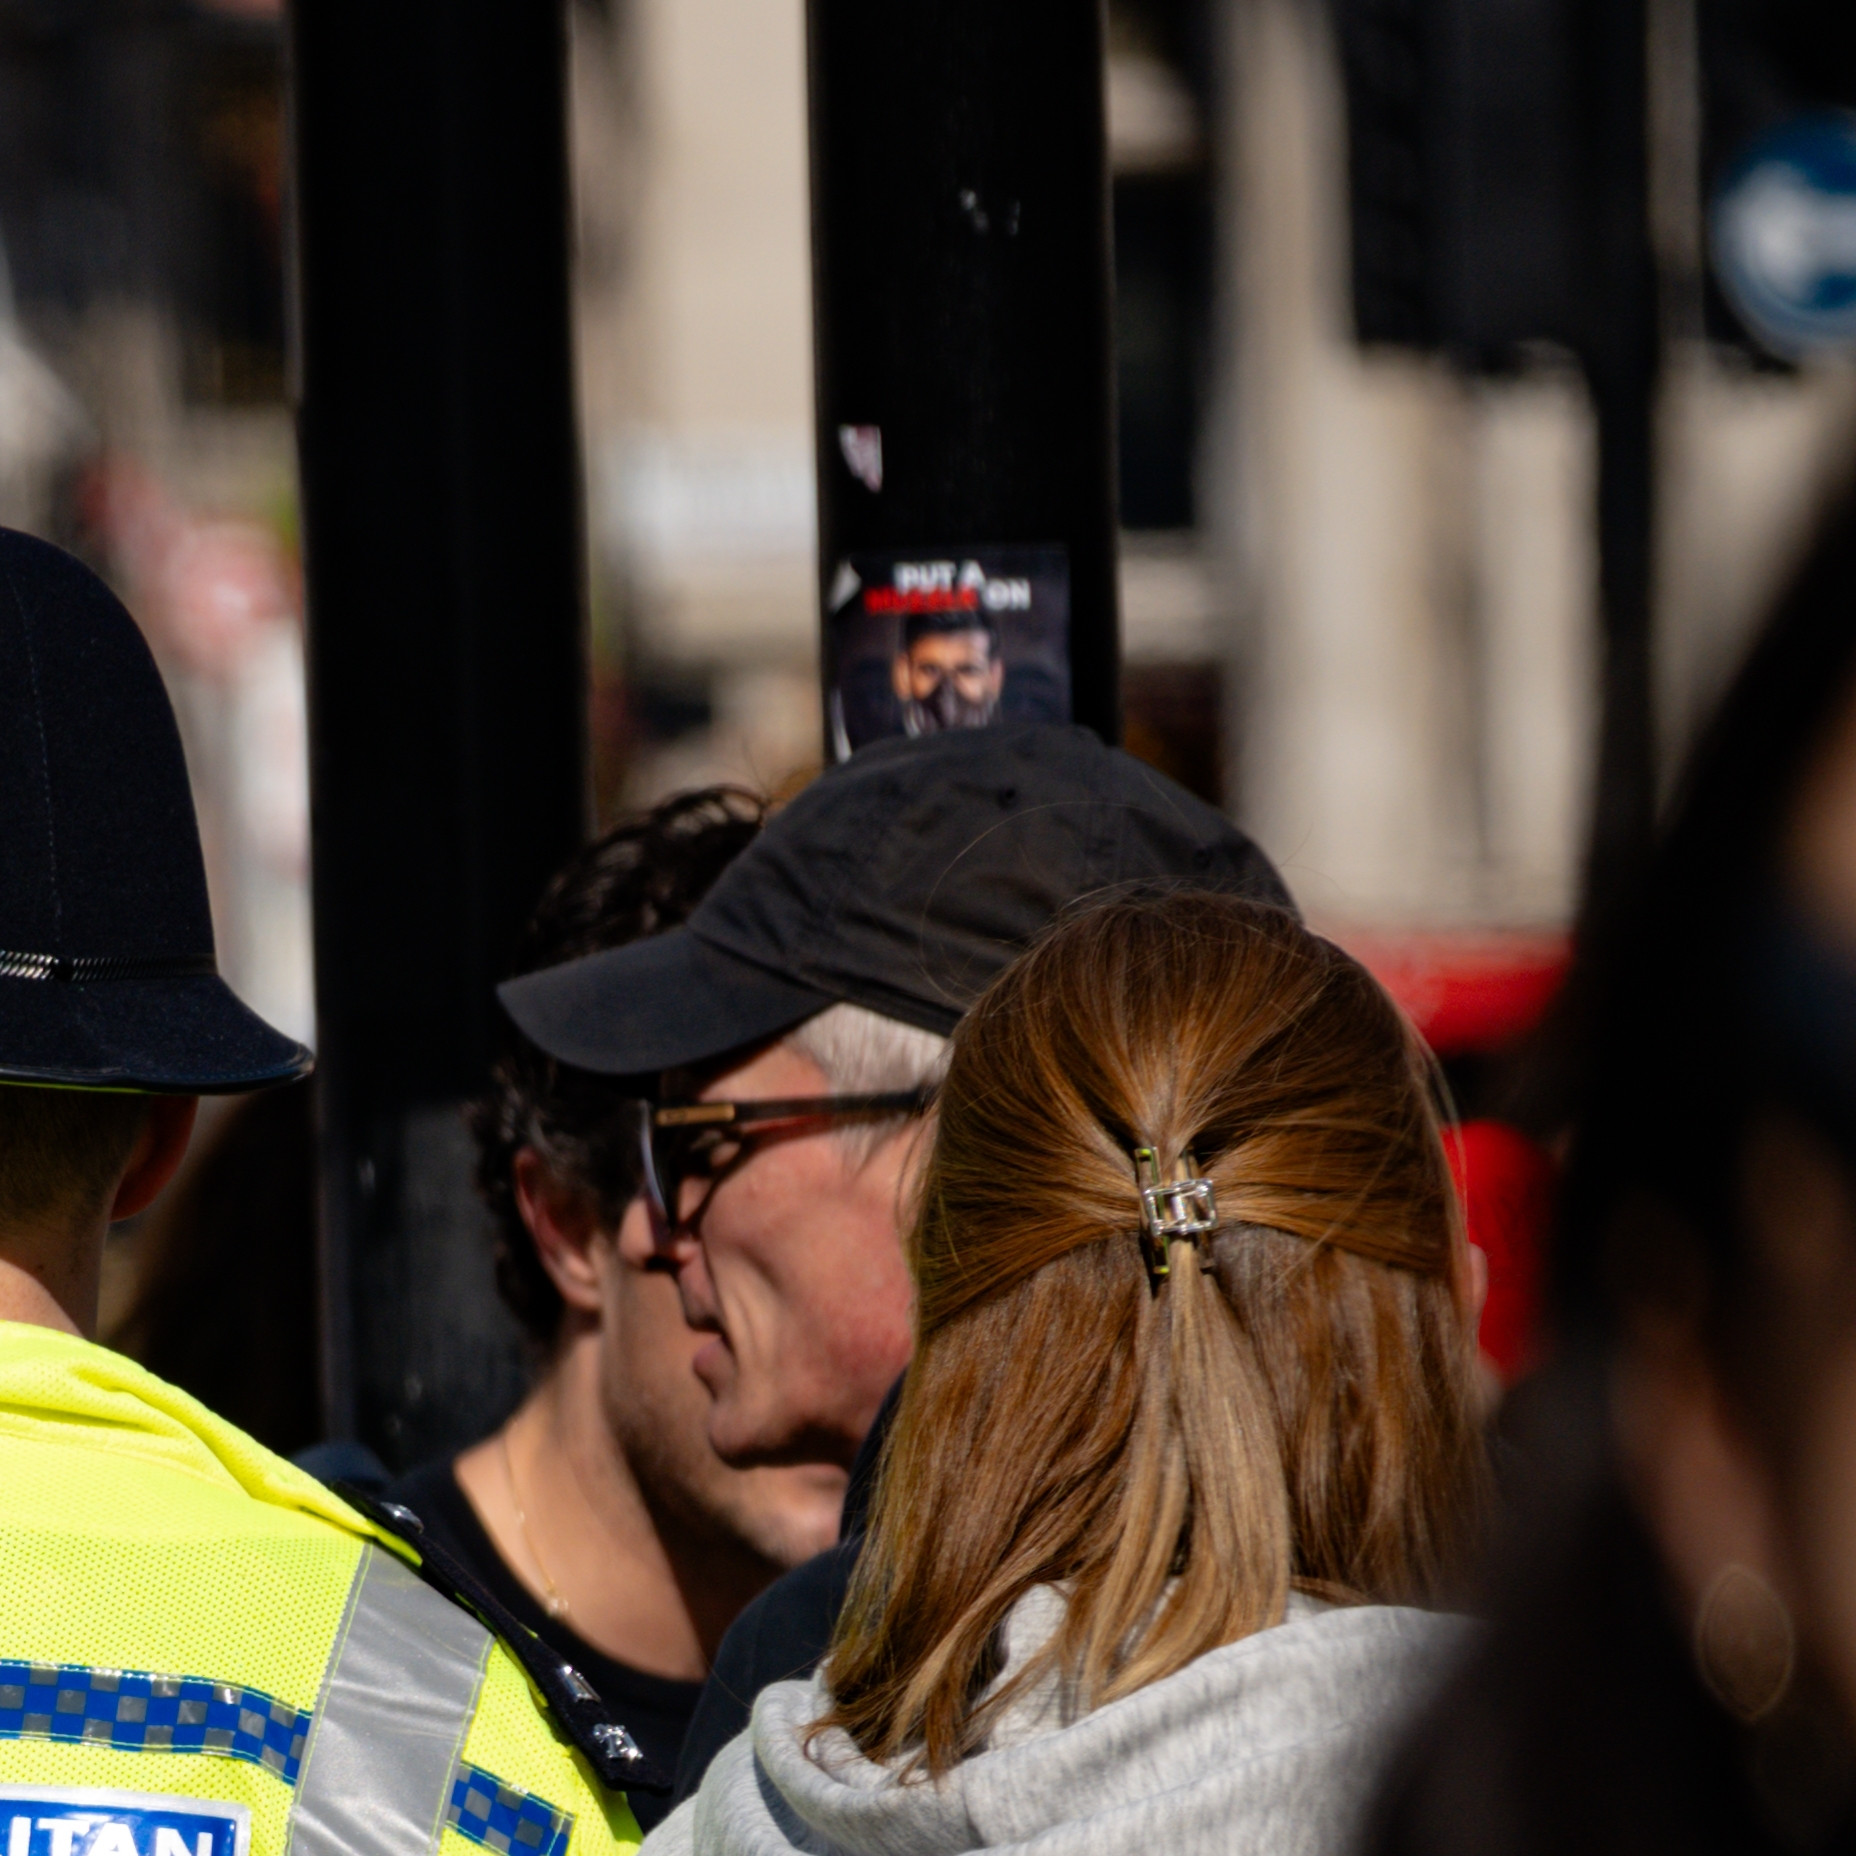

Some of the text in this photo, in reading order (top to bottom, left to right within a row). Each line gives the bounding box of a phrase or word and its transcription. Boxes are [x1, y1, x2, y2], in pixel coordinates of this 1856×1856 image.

[893, 559, 988, 595] PUT A
[982, 577, 1032, 612] ON
